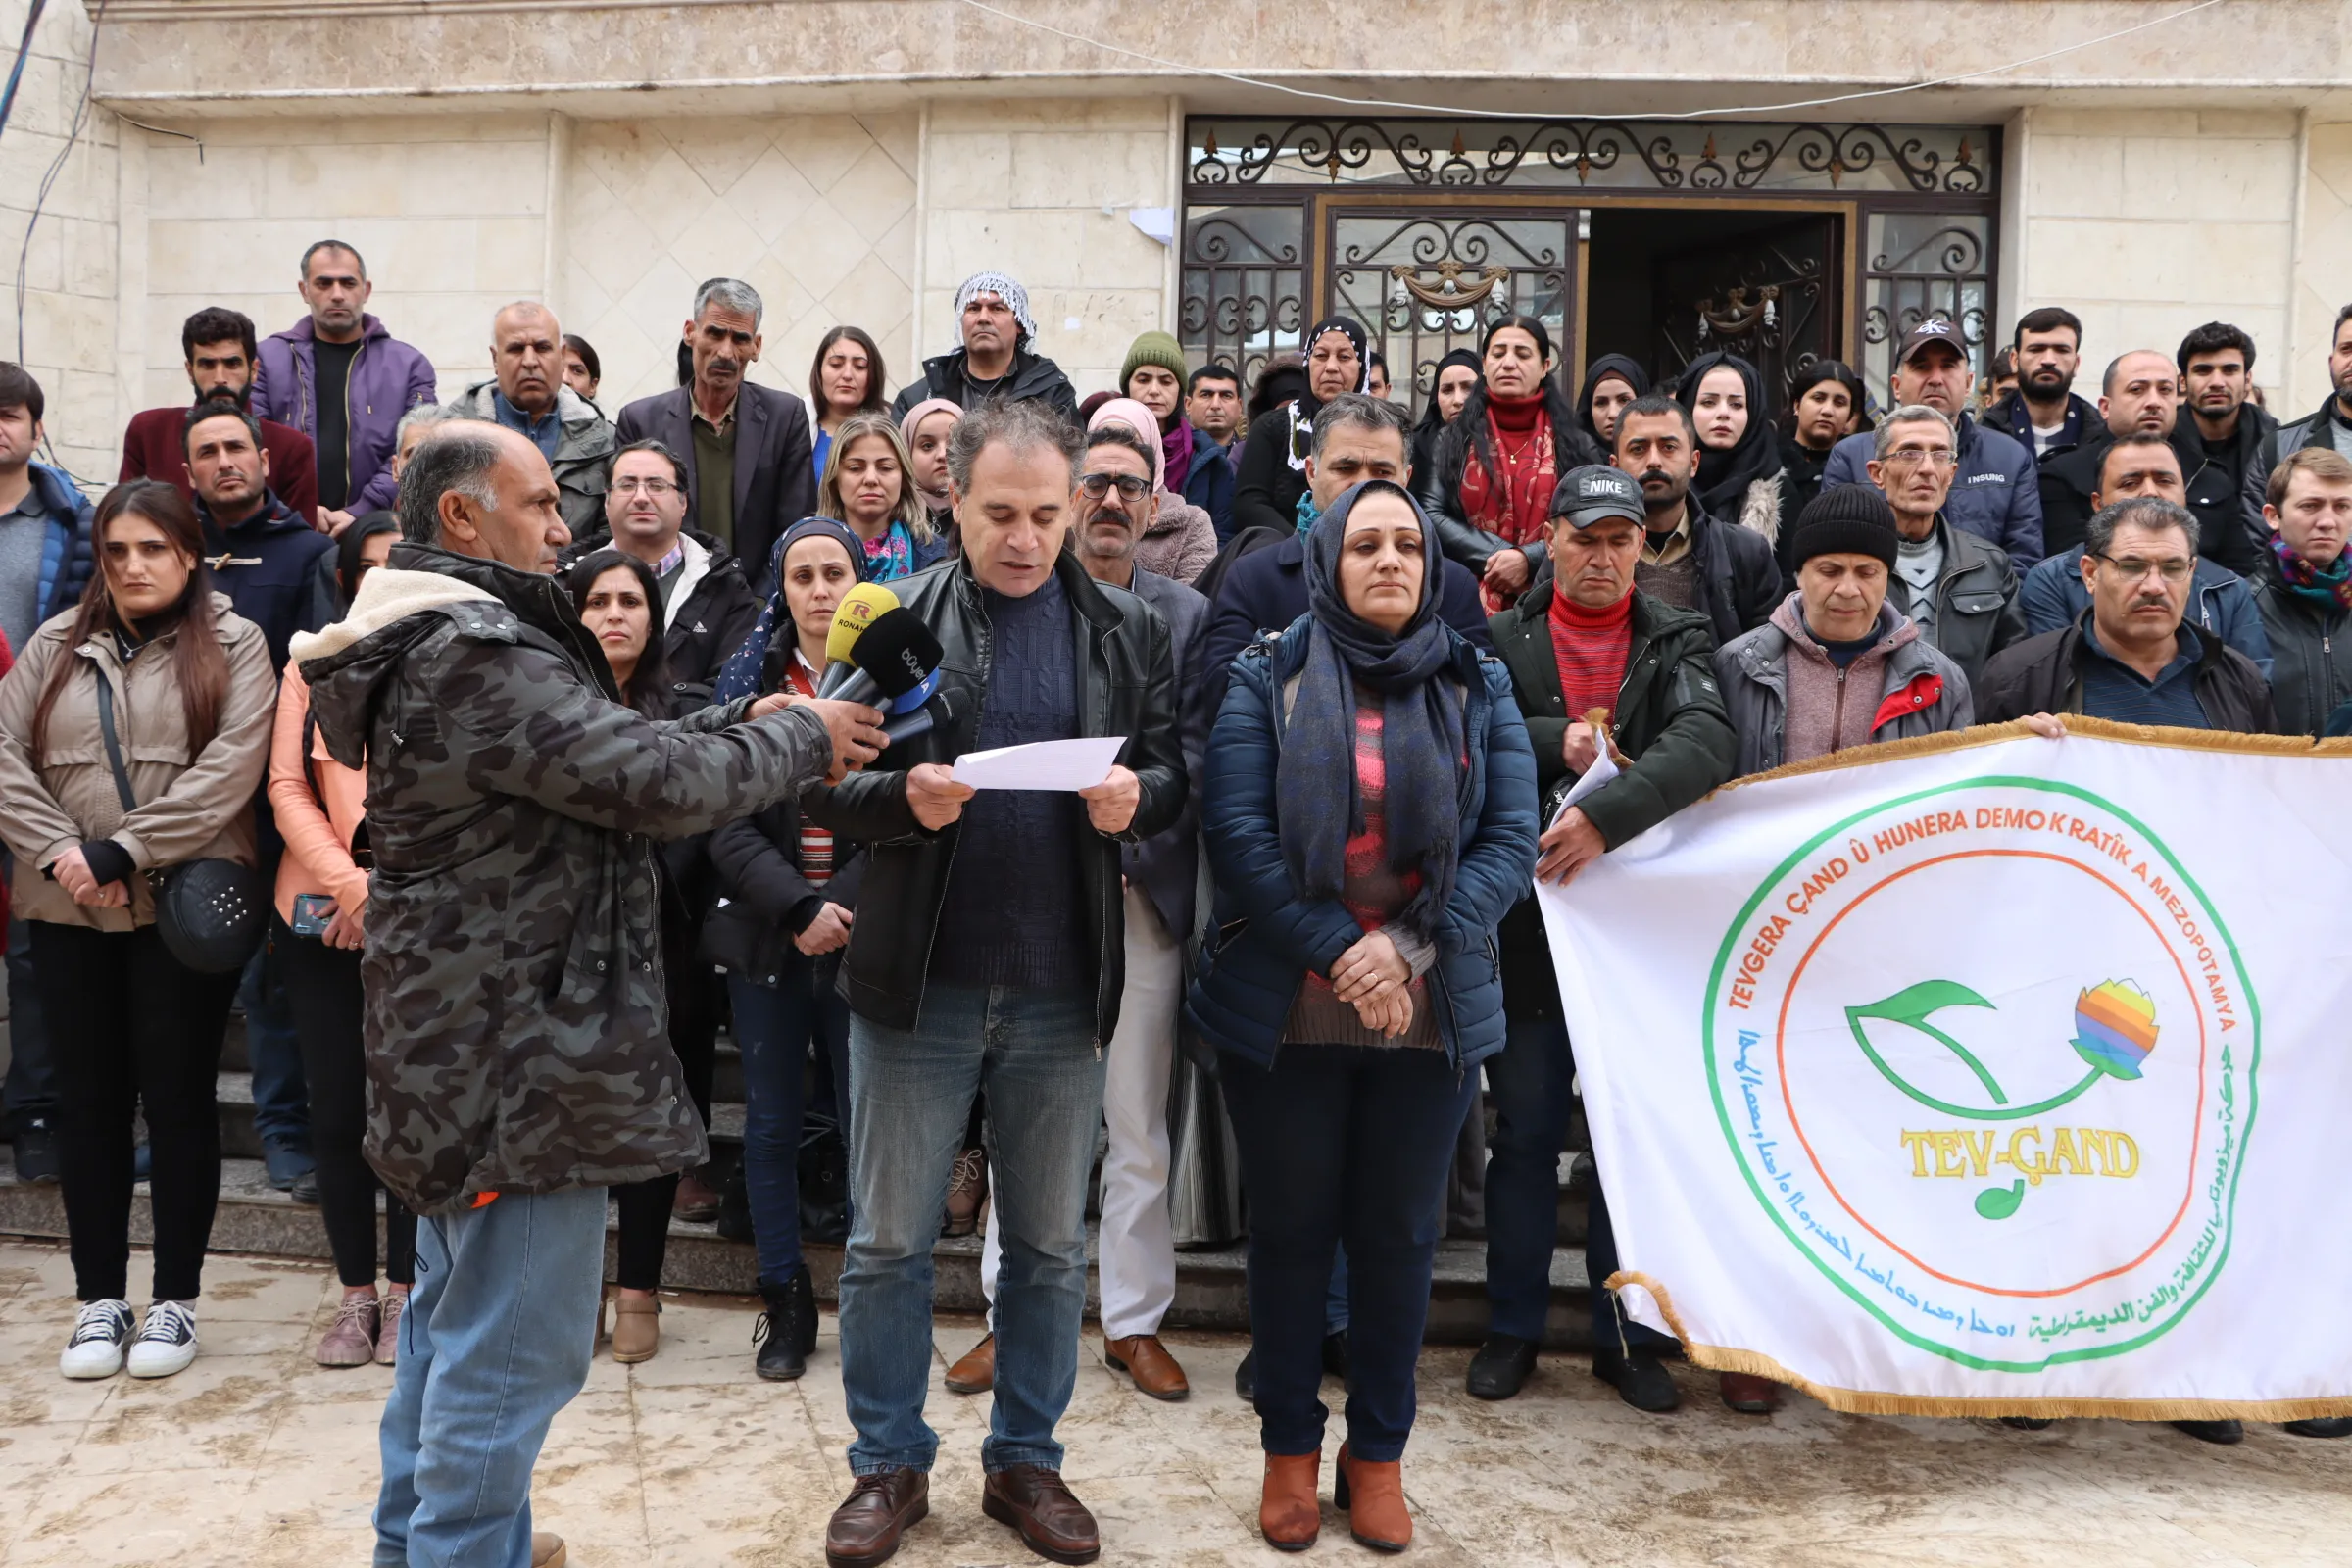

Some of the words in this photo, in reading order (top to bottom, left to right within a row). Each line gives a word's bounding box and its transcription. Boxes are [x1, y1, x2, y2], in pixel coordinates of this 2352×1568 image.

[1590, 479, 1623, 494] NIKE
[1729, 914, 1792, 1010] TEVGERA
[1786, 858, 1850, 915] ÇAND
[1848, 838, 1871, 864] Û
[1874, 810, 1969, 855] HUNERA
[1976, 807, 2132, 866] DEMOKRATÎK
[2132, 862, 2148, 881] A
[2149, 876, 2237, 1032] MEZOPOTAMYA
[2218, 1044, 2234, 1122] حركة
[2172, 1226, 2218, 1291] للثقافة
[2028, 1300, 2135, 1343] الديمقراطية
[2136, 1282, 2179, 1323] والفن
